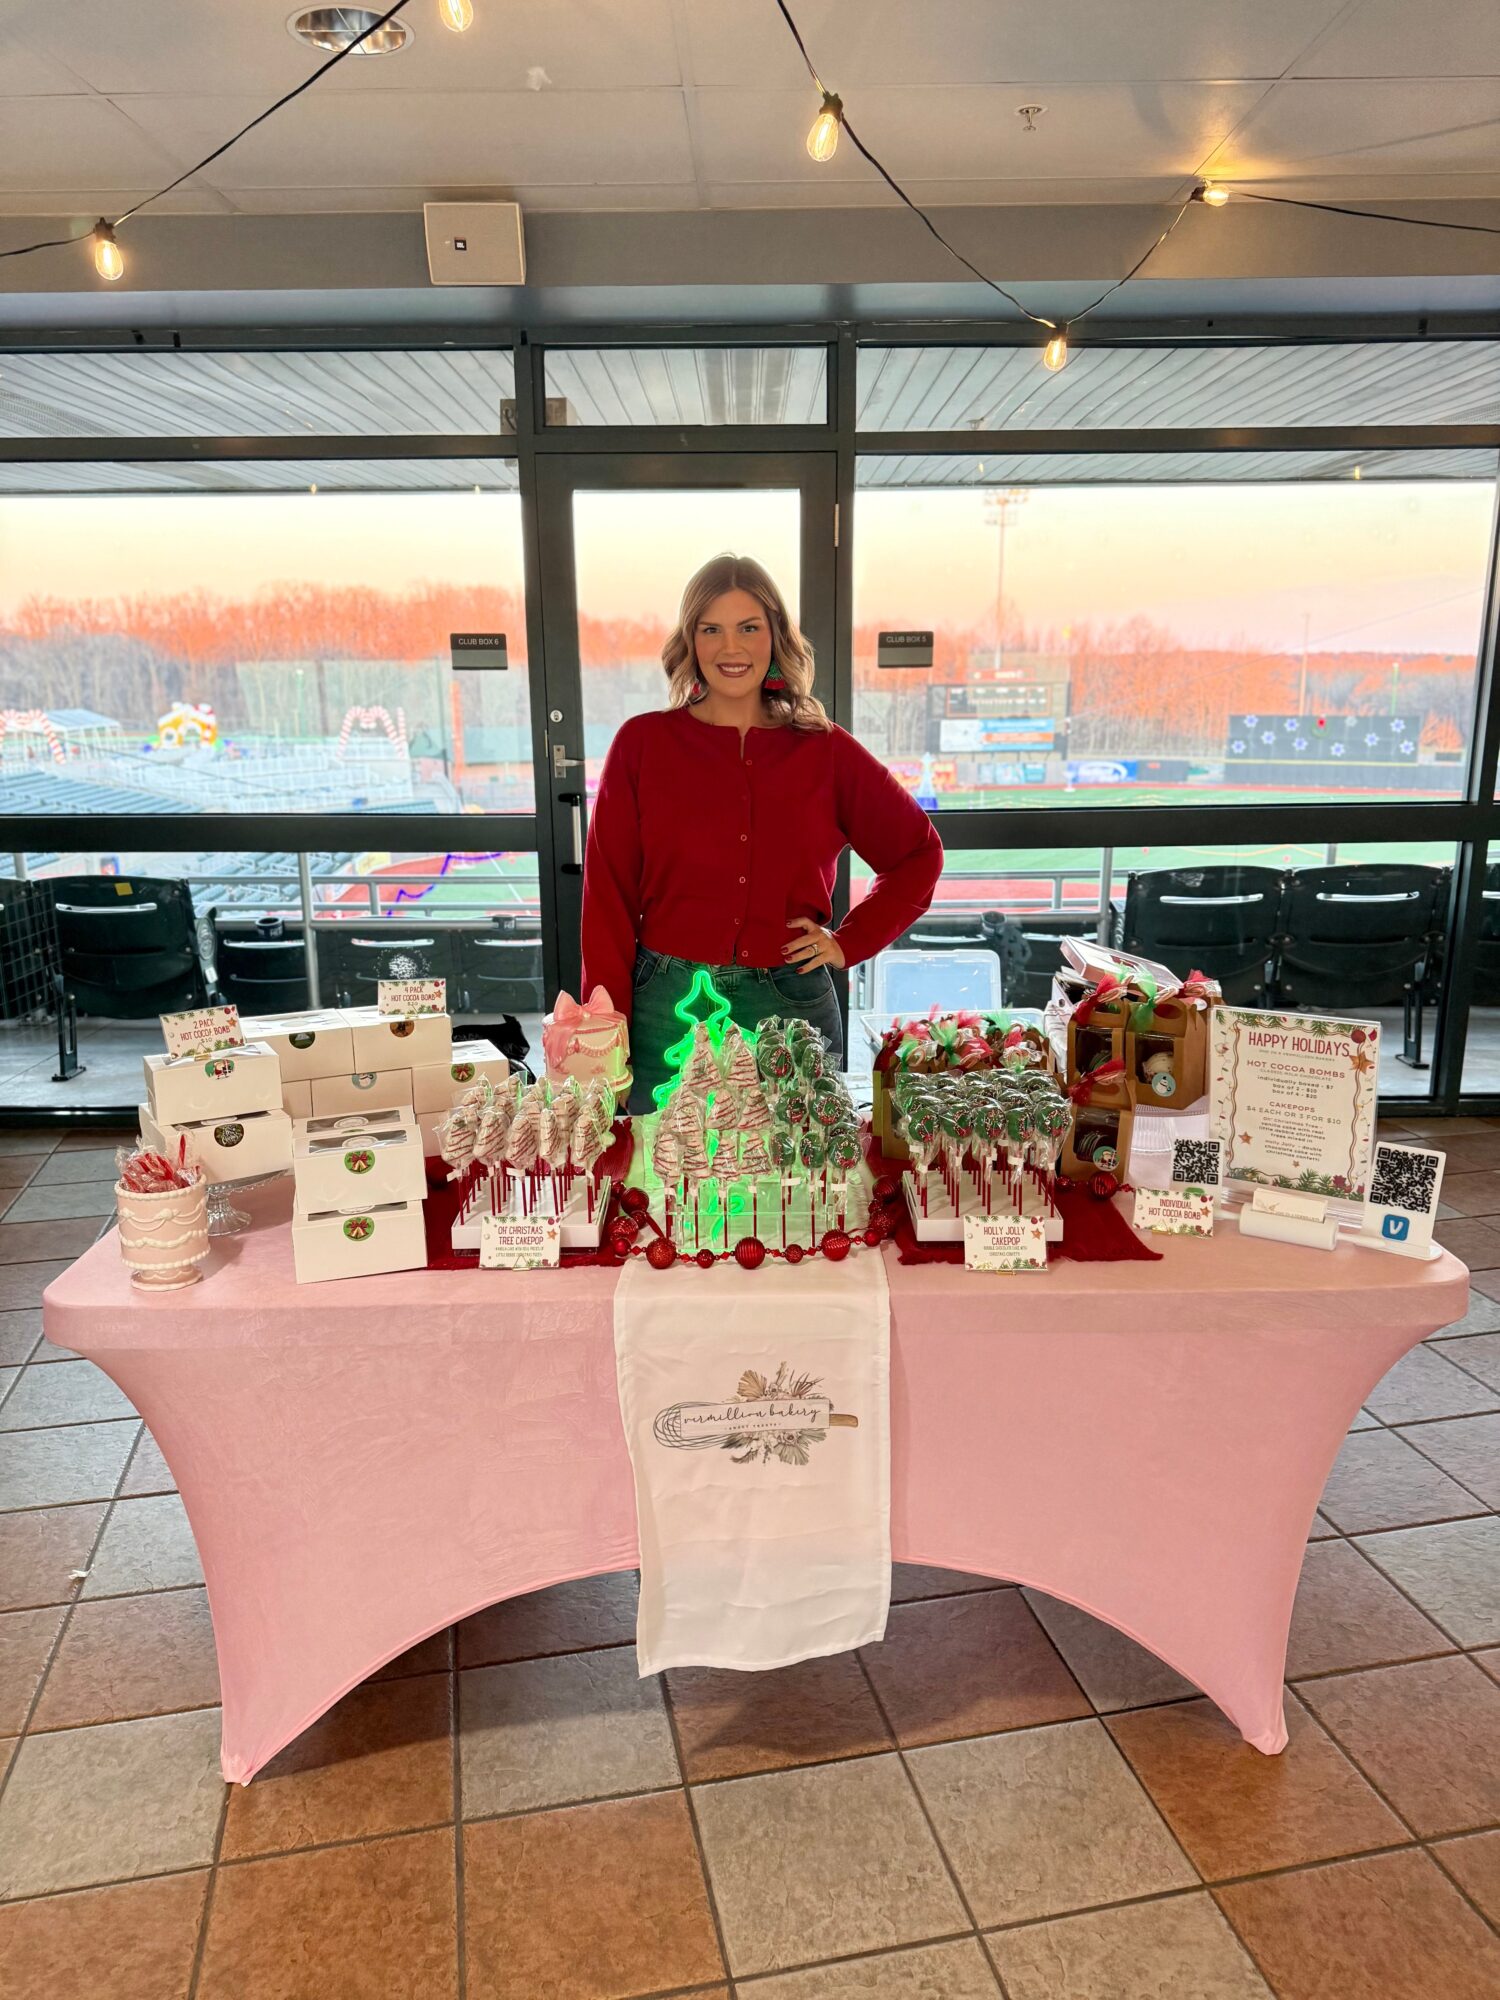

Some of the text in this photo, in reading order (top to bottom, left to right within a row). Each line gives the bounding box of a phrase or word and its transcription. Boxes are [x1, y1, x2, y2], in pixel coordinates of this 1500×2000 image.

[193, 1019, 215, 1029] 2 PACK
[180, 1032, 192, 1040] HOT
[214, 1026, 231, 1035] BOMB
[1248, 1032, 1350, 1057] HAPPY HOLIDAYS
[1247, 1060, 1345, 1078] HOT COCOA BOMBS
[1259, 1107, 1281, 1115] EACH
[1269, 1101, 1315, 1113] CAKEPOPS
[1160, 1199, 1192, 1209] INDIVIDUAL
[1149, 1208, 1201, 1220] HOT COCOA BOMB
[509, 1226, 543, 1234] CHRISTMAS
[984, 1227, 1025, 1235] HOLLY JOLLY
[499, 1237, 544, 1245] TREE CAKEPOP
[992, 1237, 1020, 1245] CAKEPOP
[684, 1403, 821, 1424] vermillion bakery
